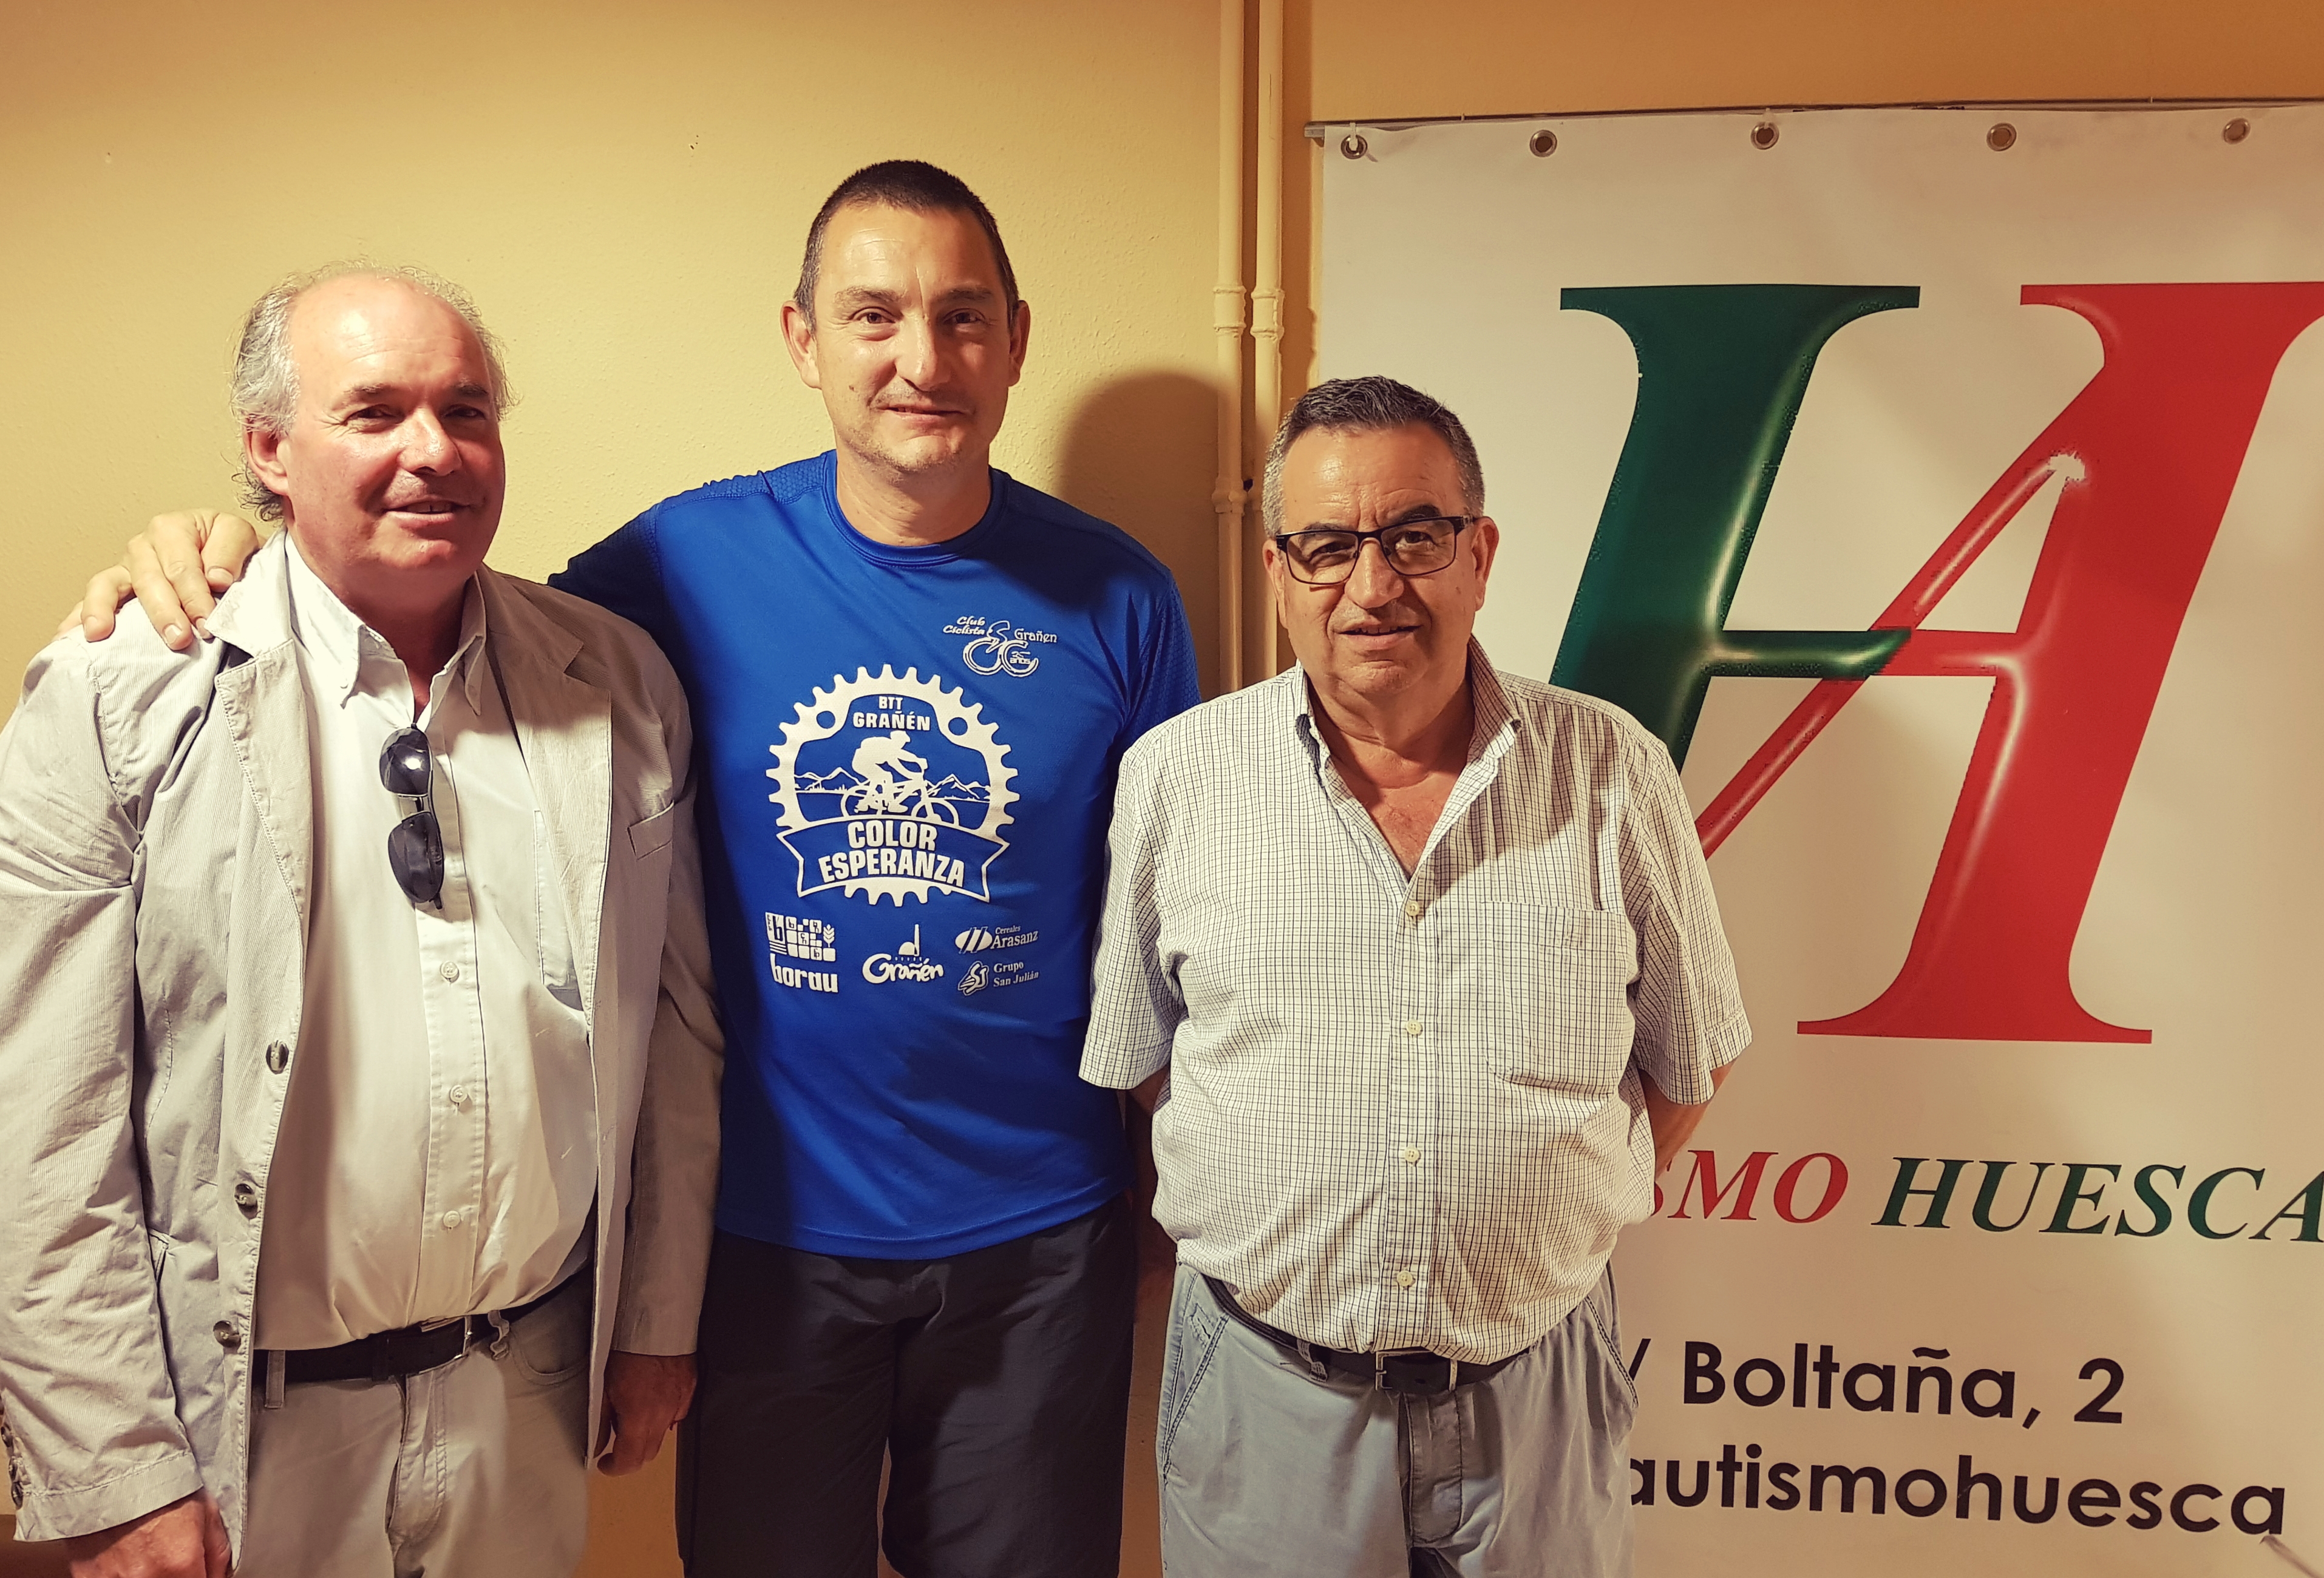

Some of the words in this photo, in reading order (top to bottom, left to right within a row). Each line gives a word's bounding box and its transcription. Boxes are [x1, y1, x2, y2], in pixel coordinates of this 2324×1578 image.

[943, 625, 985, 635] Ciclista
[957, 616, 985, 626] Club
[878, 696, 903, 710] BTT
[853, 709, 931, 731] GRAÑÉN
[848, 820, 938, 850] COLOR
[818, 848, 965, 887] ESPERANZA
[990, 930, 1039, 949] Arasanz
[995, 925, 1021, 935] Cereales
[769, 953, 838, 993] borau
[862, 953, 944, 984] Grañén
[993, 961, 1024, 973] Grupo
[993, 977, 1011, 987] San
[1013, 970, 1039, 984] Julián
[1870, 1157, 2324, 1243] HUESCA
[1684, 1341, 2041, 1429] Boltaña,
[2074, 1358, 2125, 1424] 2
[1630, 1443, 2285, 1536] autismohuesca
